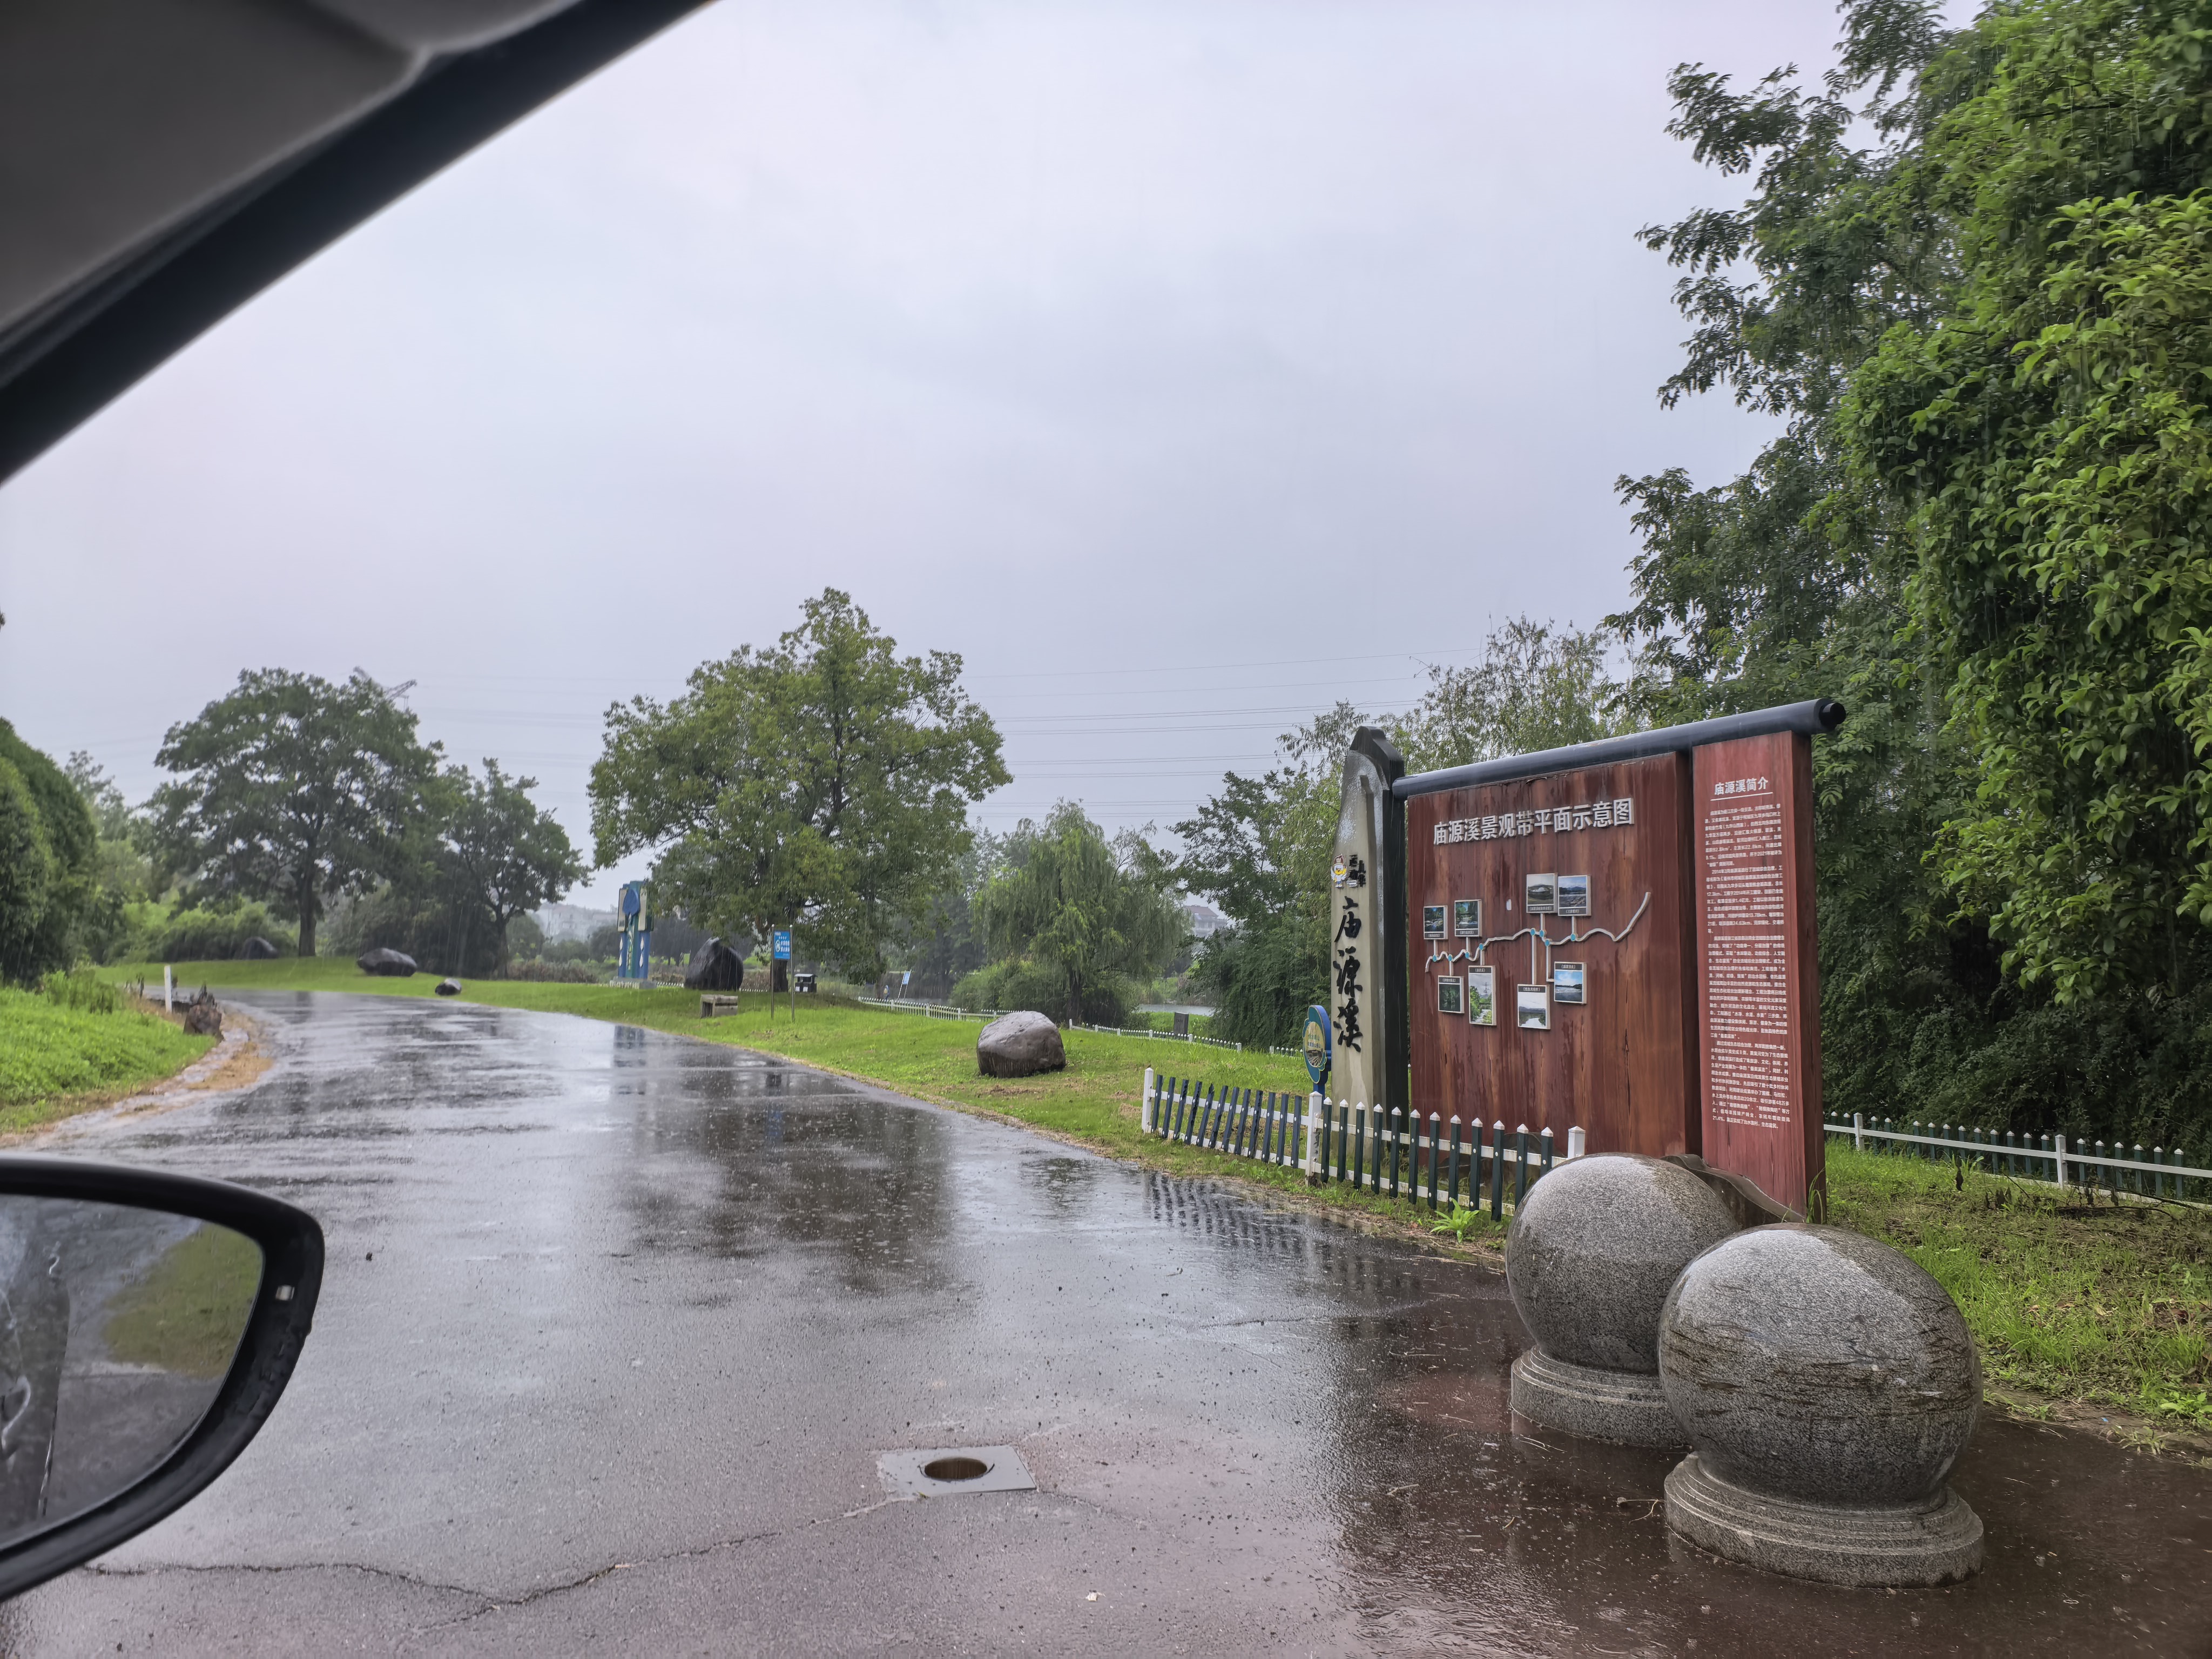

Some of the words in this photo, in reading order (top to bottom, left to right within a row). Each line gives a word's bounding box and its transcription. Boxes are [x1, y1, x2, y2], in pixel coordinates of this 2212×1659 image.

[1714, 776, 1768, 795] 庙源溪简介
[1434, 798, 1635, 845] 庙源溪景观带平面示意图
[1334, 895, 1363, 1053] 庙源溪
